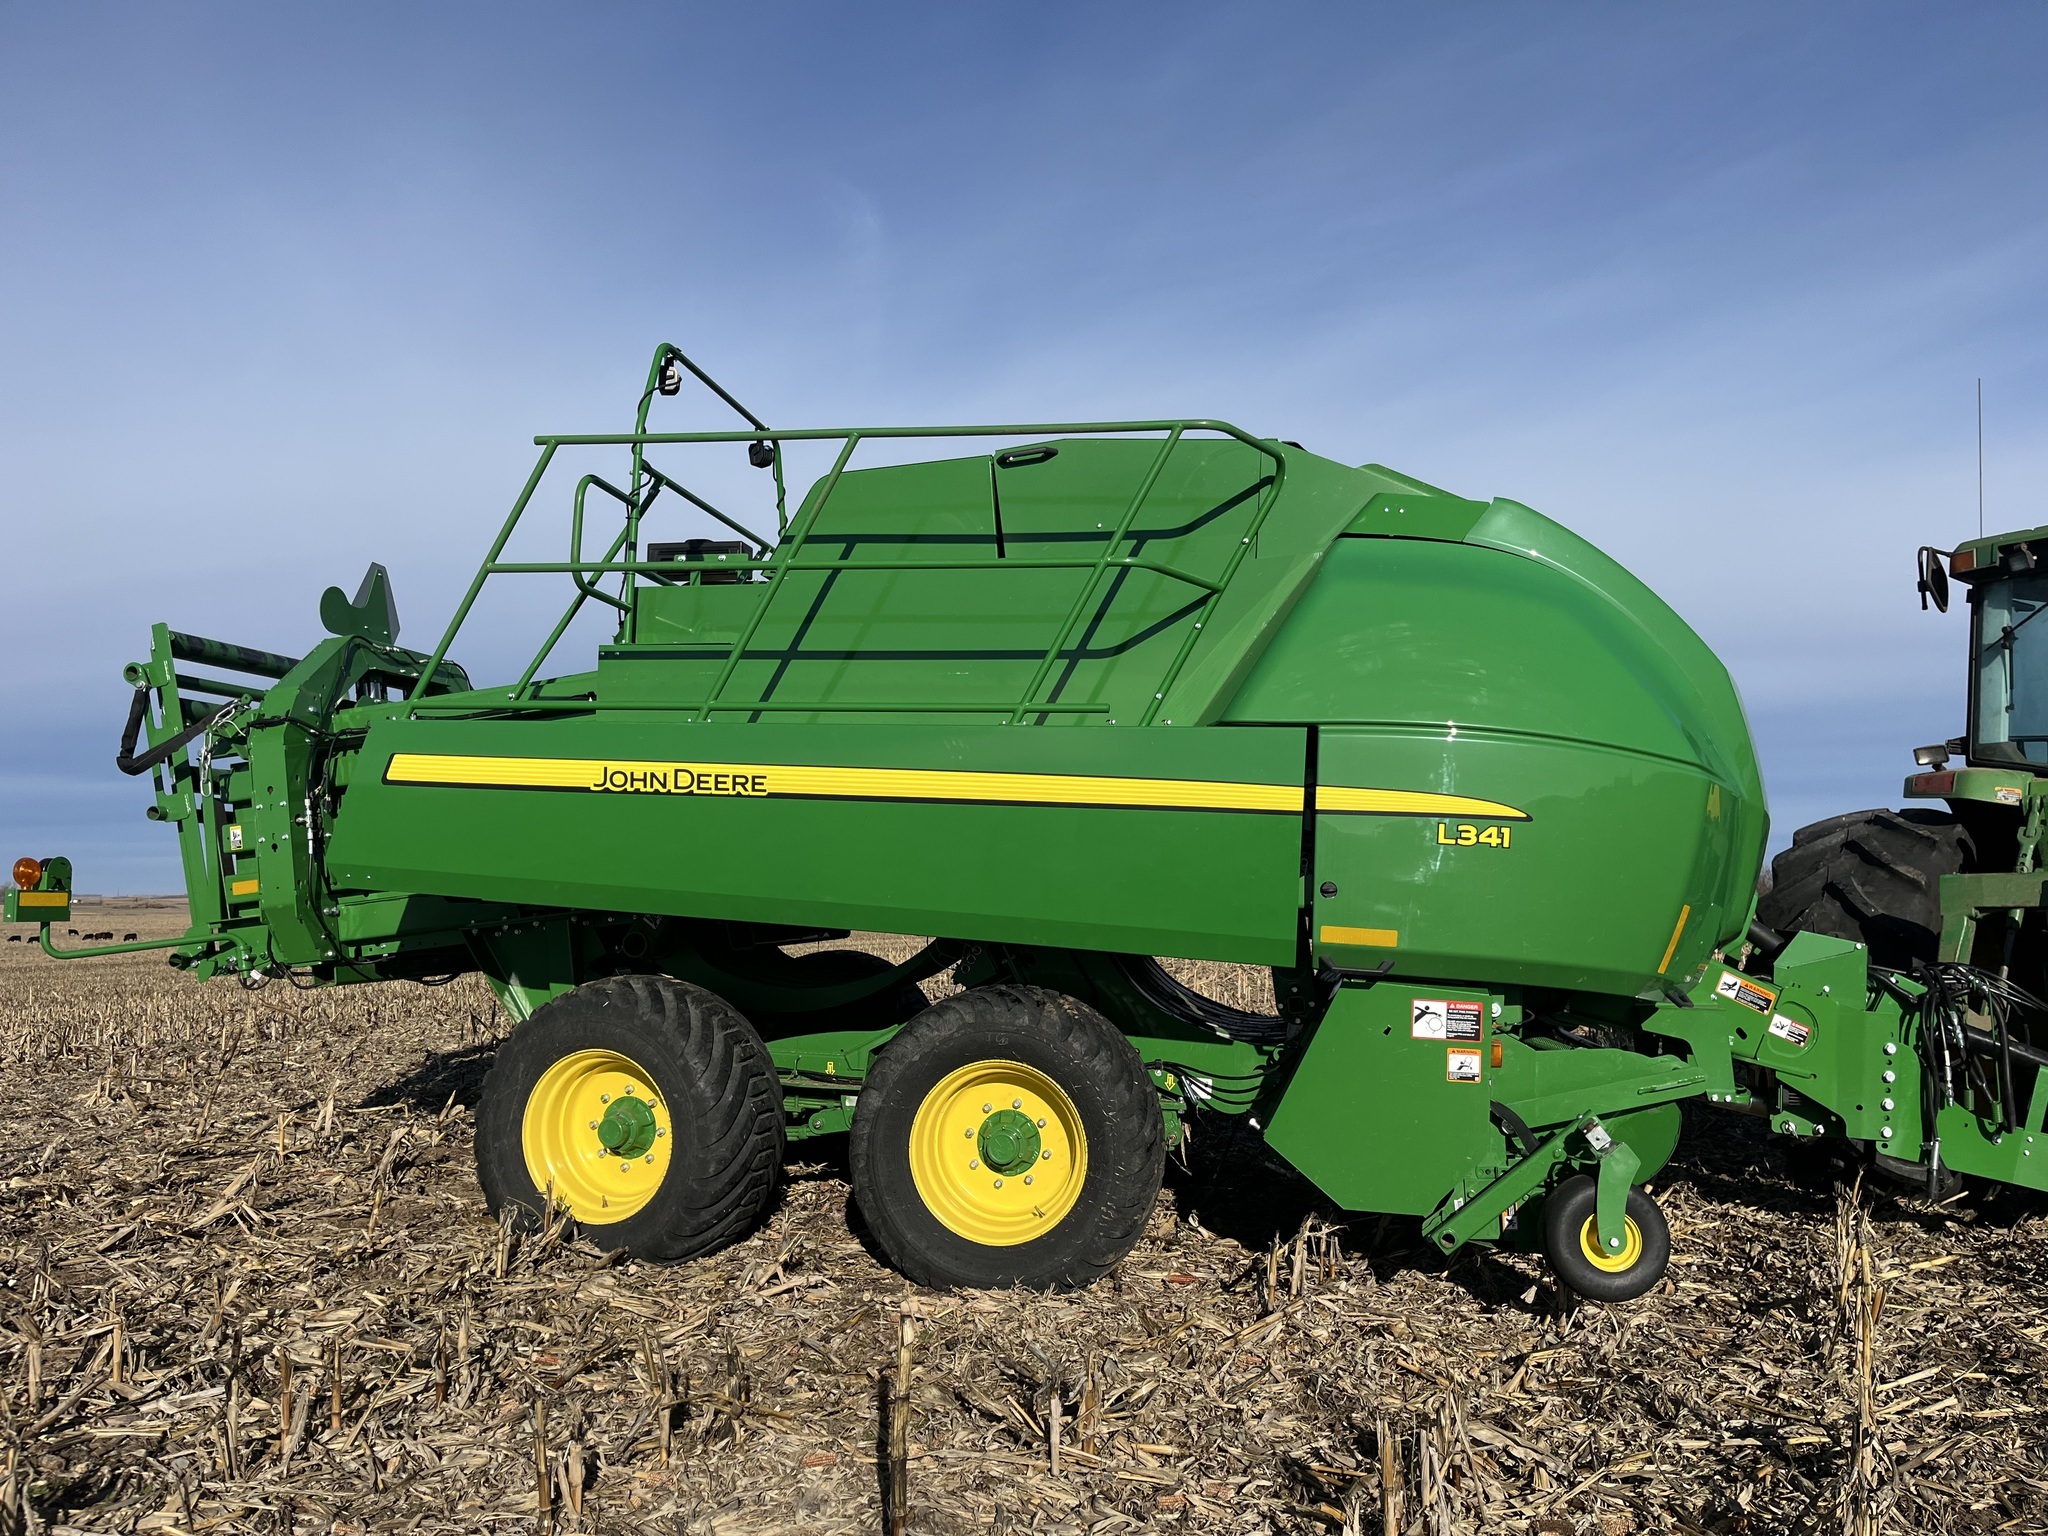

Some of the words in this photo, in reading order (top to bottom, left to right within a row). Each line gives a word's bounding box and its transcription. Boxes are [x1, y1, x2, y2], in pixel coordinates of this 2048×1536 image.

[593, 766, 667, 790] JOHN
[673, 768, 767, 793] DEERE
[1437, 822, 1511, 849] L341
[1747, 985, 1771, 998] WARNING
